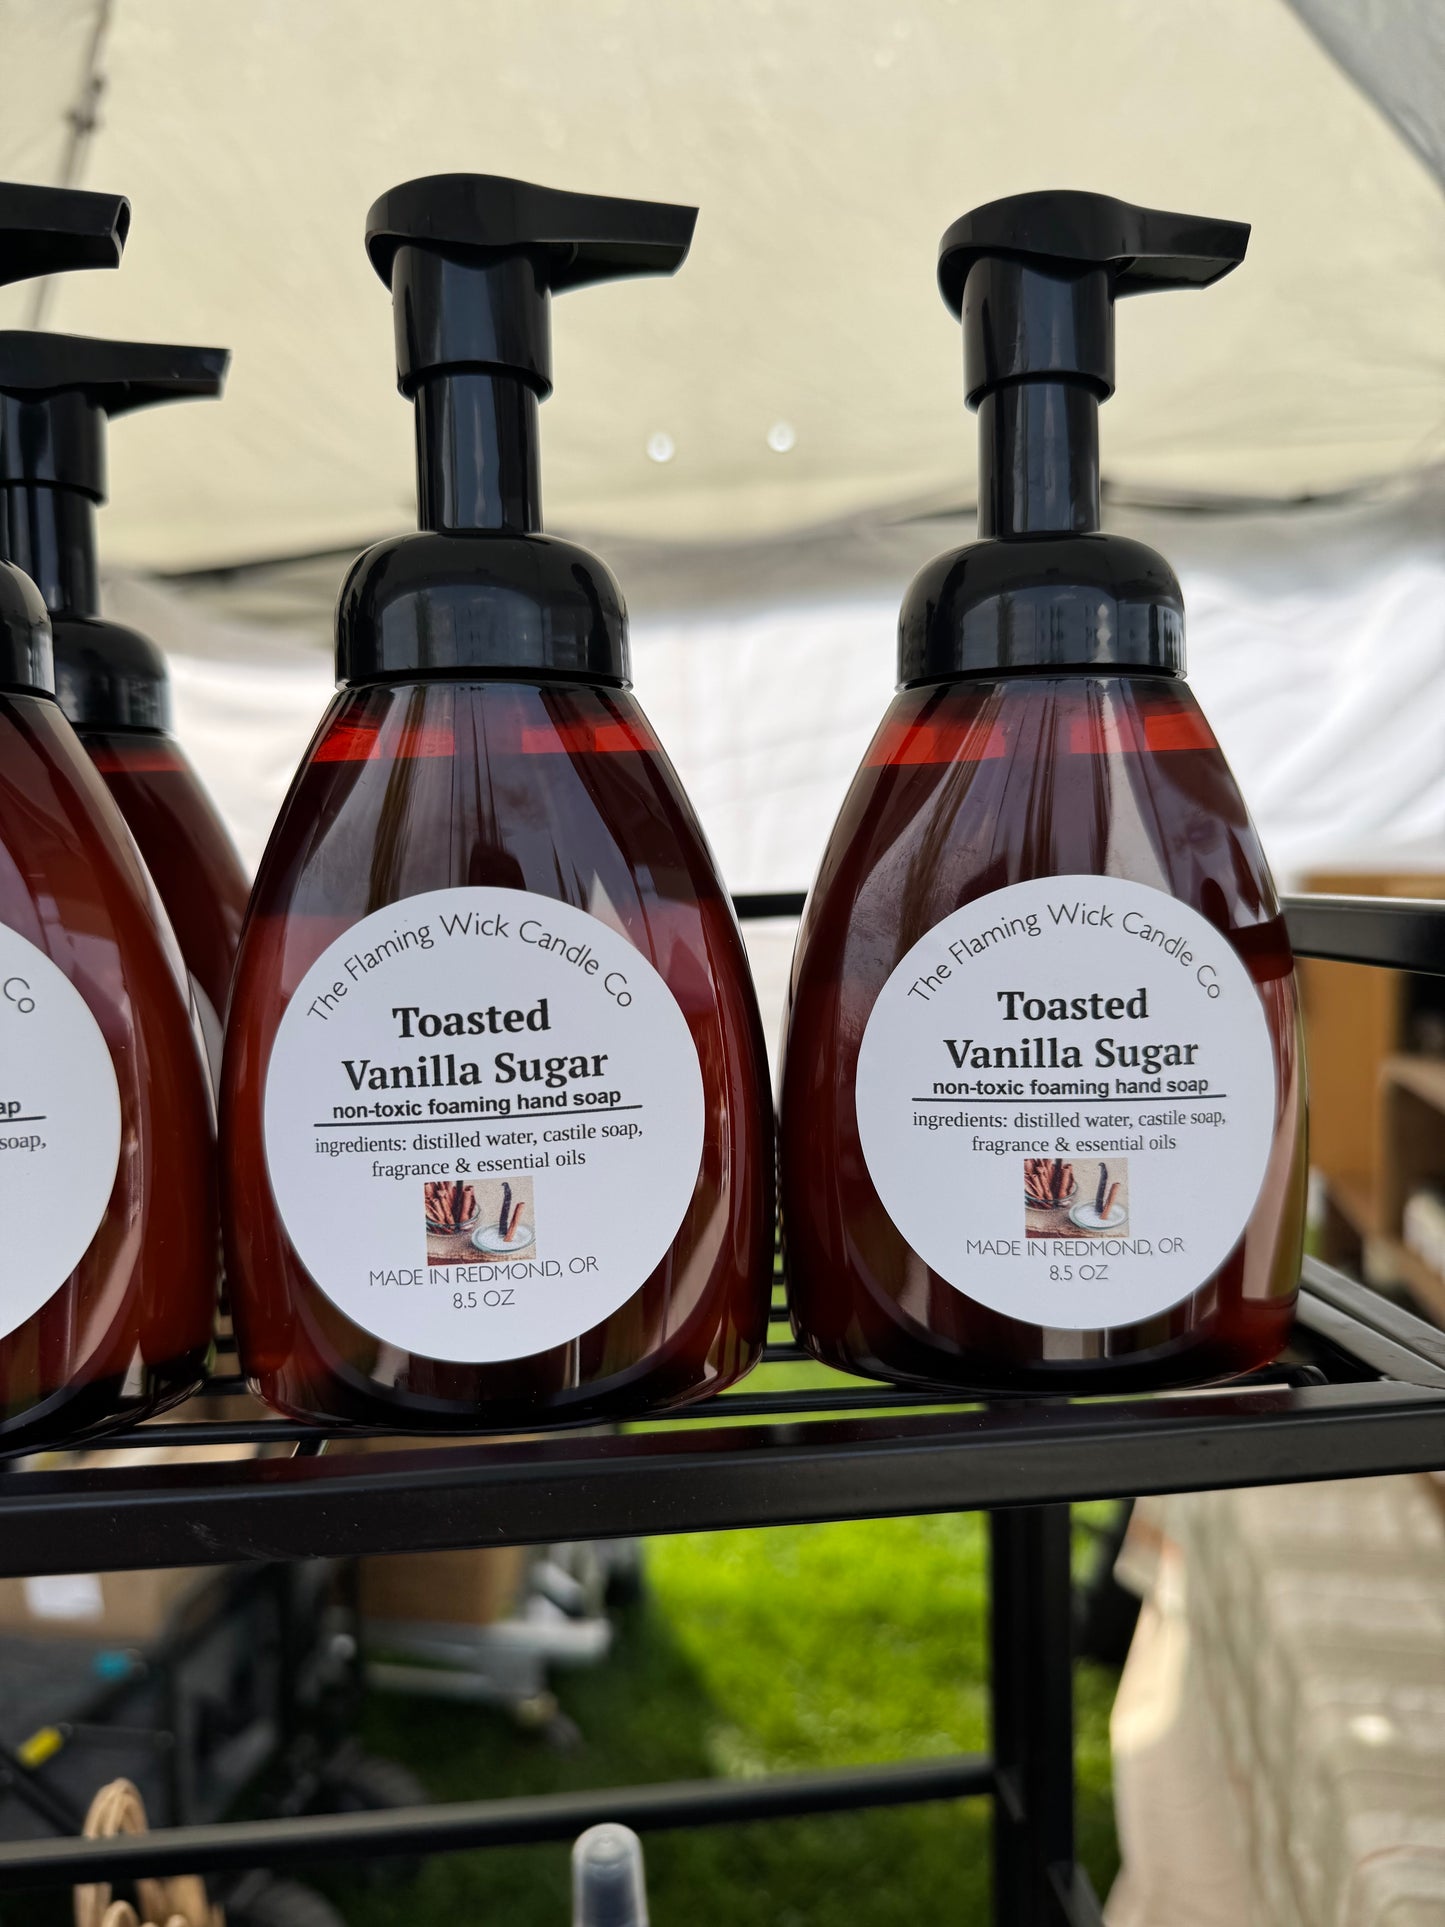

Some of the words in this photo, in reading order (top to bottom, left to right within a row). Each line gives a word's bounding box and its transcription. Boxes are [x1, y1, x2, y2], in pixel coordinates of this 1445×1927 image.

[307, 978, 349, 1023] The
[344, 924, 435, 982] Flaming
[439, 912, 509, 937] Wick
[518, 920, 599, 975] Candle
[604, 972, 633, 1007] Co
[908, 960, 952, 1002] The
[948, 911, 1041, 966] Flaming
[1047, 903, 1114, 929] Wick
[1122, 911, 1194, 966] Candle
[1196, 965, 1220, 999] Co
[3, 977, 35, 1014] Co
[997, 988, 1149, 1021] Toasted
[392, 998, 551, 1039] Toasted
[342, 1054, 482, 1090] Vanilla
[495, 1052, 609, 1088] Sugar
[943, 1038, 1082, 1069] Vanilla
[1095, 1038, 1199, 1074] Sugar
[933, 1079, 1024, 1095] non-toxic
[1030, 1079, 1109, 1098] foaming
[1115, 1078, 1161, 1094] hand
[1166, 1077, 1209, 1095] soap
[333, 1100, 422, 1119] non-toxic
[428, 1095, 511, 1116] foaming
[516, 1091, 567, 1109] hand
[573, 1088, 621, 1108] soap
[913, 1111, 1008, 1131] ingredients:
[1014, 1111, 1080, 1129] distilled
[1085, 1113, 1134, 1130] water,
[1138, 1110, 1186, 1125] castile
[1191, 1110, 1225, 1126] soap,
[315, 1135, 407, 1157] ingredients:
[413, 1130, 481, 1150] distilled
[485, 1129, 538, 1148] water,
[543, 1123, 596, 1143] castile
[601, 1122, 643, 1142] soap,
[972, 1136, 1049, 1155] fragrance
[1055, 1138, 1070, 1152] &
[1076, 1136, 1144, 1152] essential
[1149, 1135, 1176, 1150] oils
[372, 1159, 450, 1180] fragrance
[456, 1158, 471, 1174] &
[477, 1153, 549, 1172] essential
[556, 1150, 586, 1166] oils
[967, 1240, 1021, 1256] MADE
[1028, 1241, 1047, 1256] IN
[1053, 1239, 1154, 1256] REDMOND,
[1158, 1237, 1185, 1253] OR
[370, 1270, 423, 1286] MADE
[430, 1268, 449, 1283] IN
[456, 1260, 564, 1283] REDMOND,
[569, 1256, 599, 1274] OR
[1049, 1265, 1073, 1281] 8.5
[1079, 1264, 1108, 1280] OZ
[453, 1292, 477, 1309] 8.5
[483, 1289, 515, 1307] OZ
